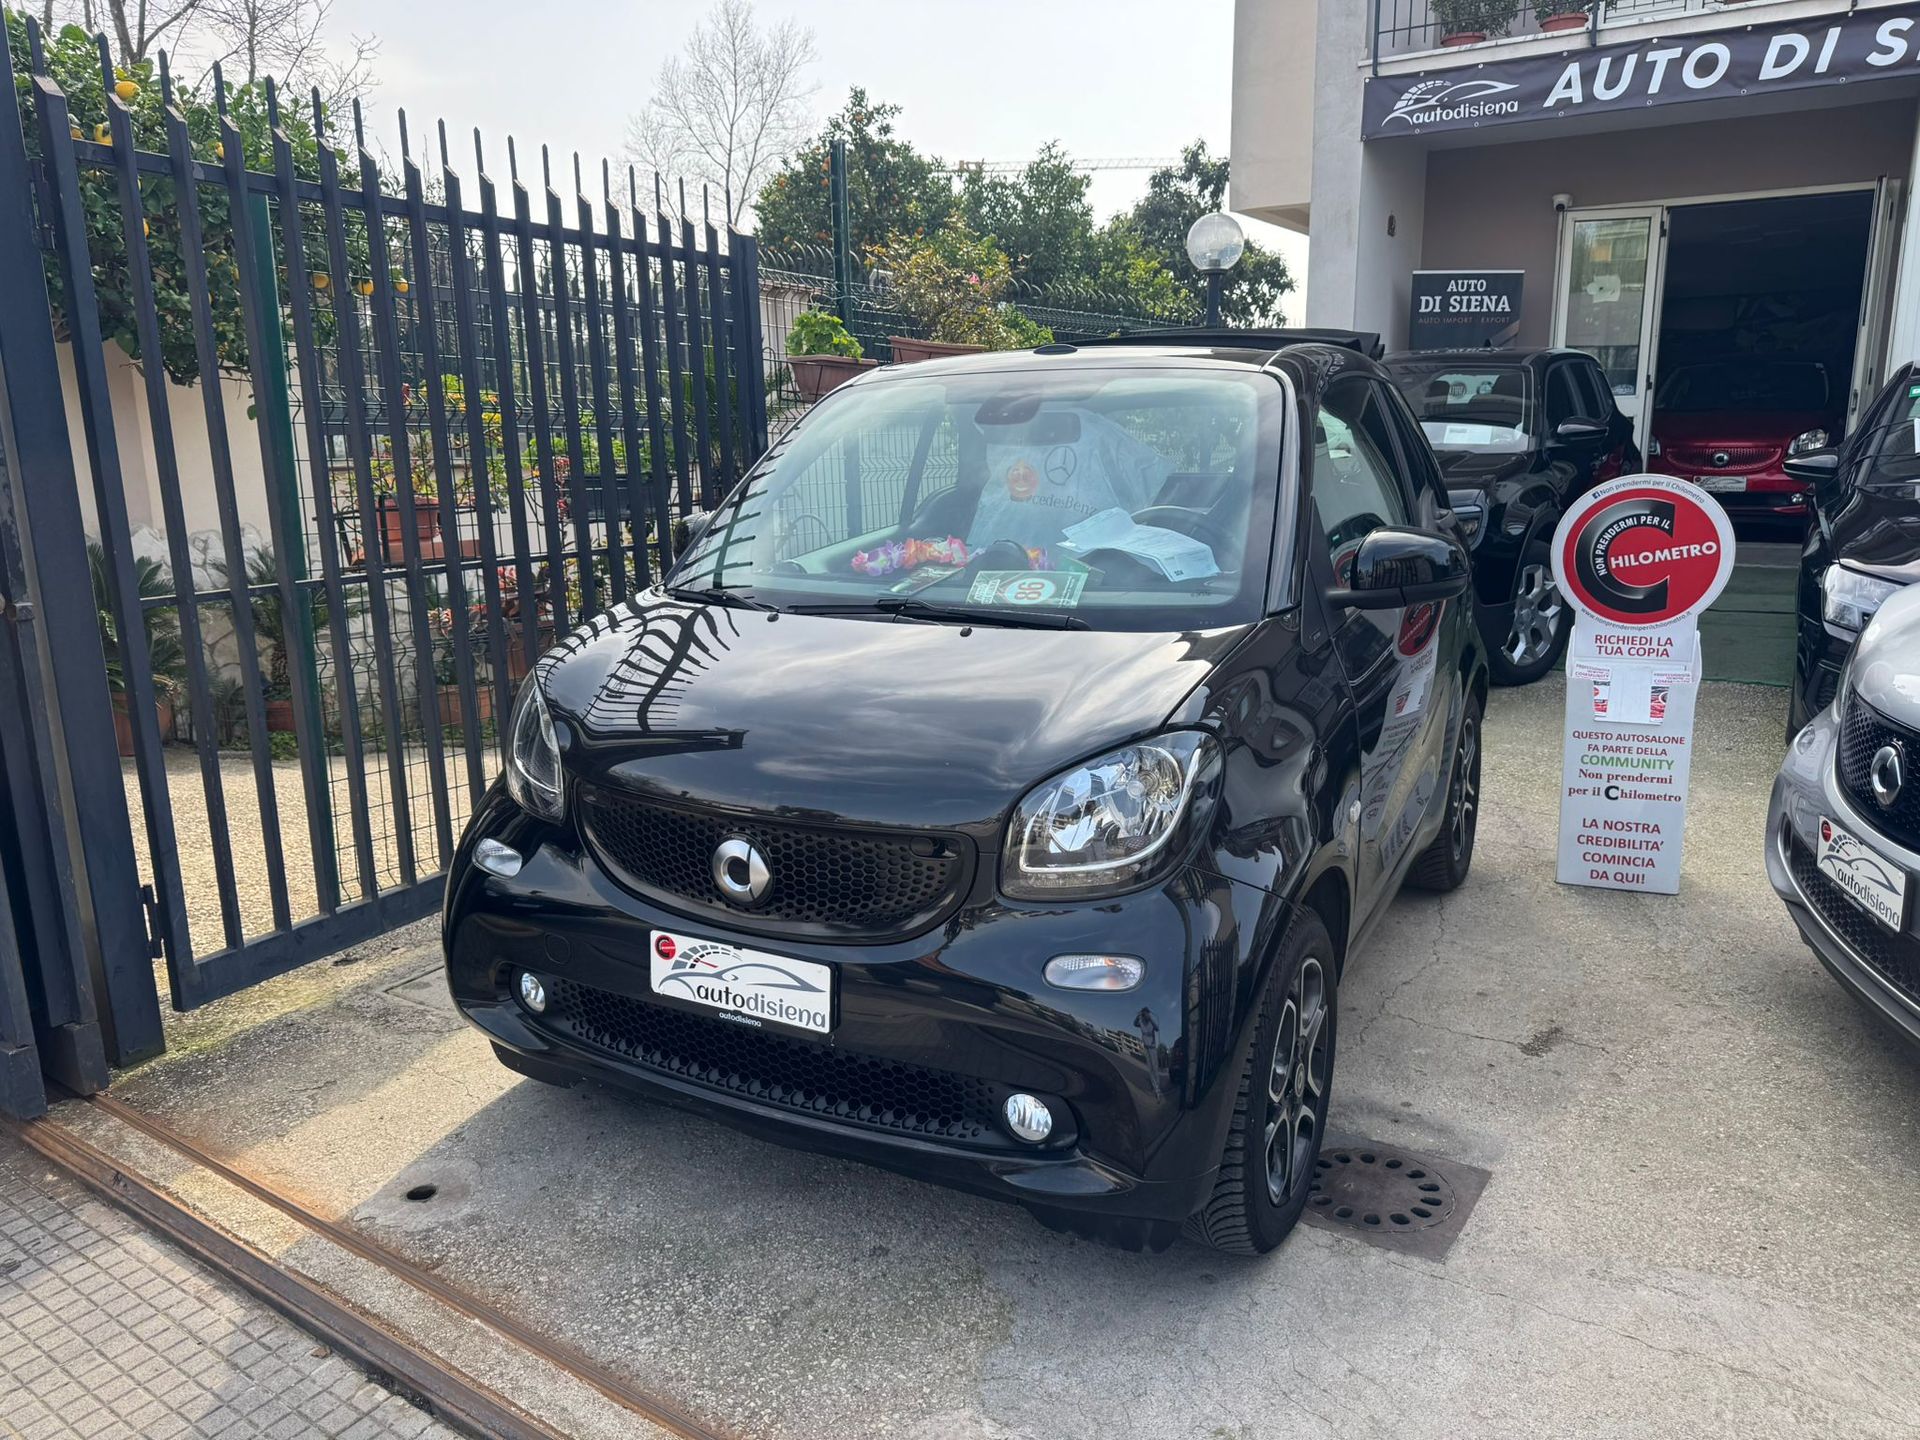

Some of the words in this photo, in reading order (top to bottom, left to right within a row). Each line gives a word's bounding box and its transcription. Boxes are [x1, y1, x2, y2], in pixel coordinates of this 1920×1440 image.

[1542, 41, 1732, 108] AUTO
[1757, 26, 1842, 82] DI
[1865, 17, 1920, 67] S
[1413, 99, 1519, 125] autodisiena
[1446, 279, 1487, 292] AUTO
[1418, 295, 1443, 313] DI
[1448, 294, 1512, 313] SIENA
[1418, 316, 1441, 325] AUTO
[1600, 485, 1615, 496] Non
[1615, 479, 1652, 490] prendermi
[1652, 479, 1665, 488] per
[1671, 482, 1705, 504] Chilometro
[1640, 515, 1659, 525] PER
[1660, 519, 1671, 530] IL
[1595, 516, 1638, 556] PRENDERMI
[1594, 557, 1608, 577] NON
[1594, 634, 1653, 647] RICHIEDI
[1657, 636, 1674, 647] LA
[1596, 645, 1623, 657] TUA
[1627, 646, 1670, 658] COPIA
[1572, 730, 1613, 742] QUESTO
[1615, 733, 1686, 745] AUTOSALONE
[1587, 744, 1600, 752] FA
[1602, 744, 1634, 755] PARTE
[1636, 746, 1668, 757] DELLA
[1580, 754, 1675, 770] COMMUNITY
[1578, 768, 1603, 780] Non
[1606, 772, 1673, 785] prendermi
[1568, 787, 1588, 797] per
[1592, 786, 1601, 796] il
[1604, 785, 1682, 802] Chilometro
[1582, 818, 1598, 829] LA
[1603, 819, 1661, 835] NOSTRA
[1582, 851, 1656, 869] COMINCIA
[1590, 869, 1609, 881] DA
[1613, 871, 1646, 884] QUI!
[1837, 868, 1900, 926] autodisiena
[696, 984, 826, 1029] autodisiena
[718, 1011, 762, 1028] autodisiena
